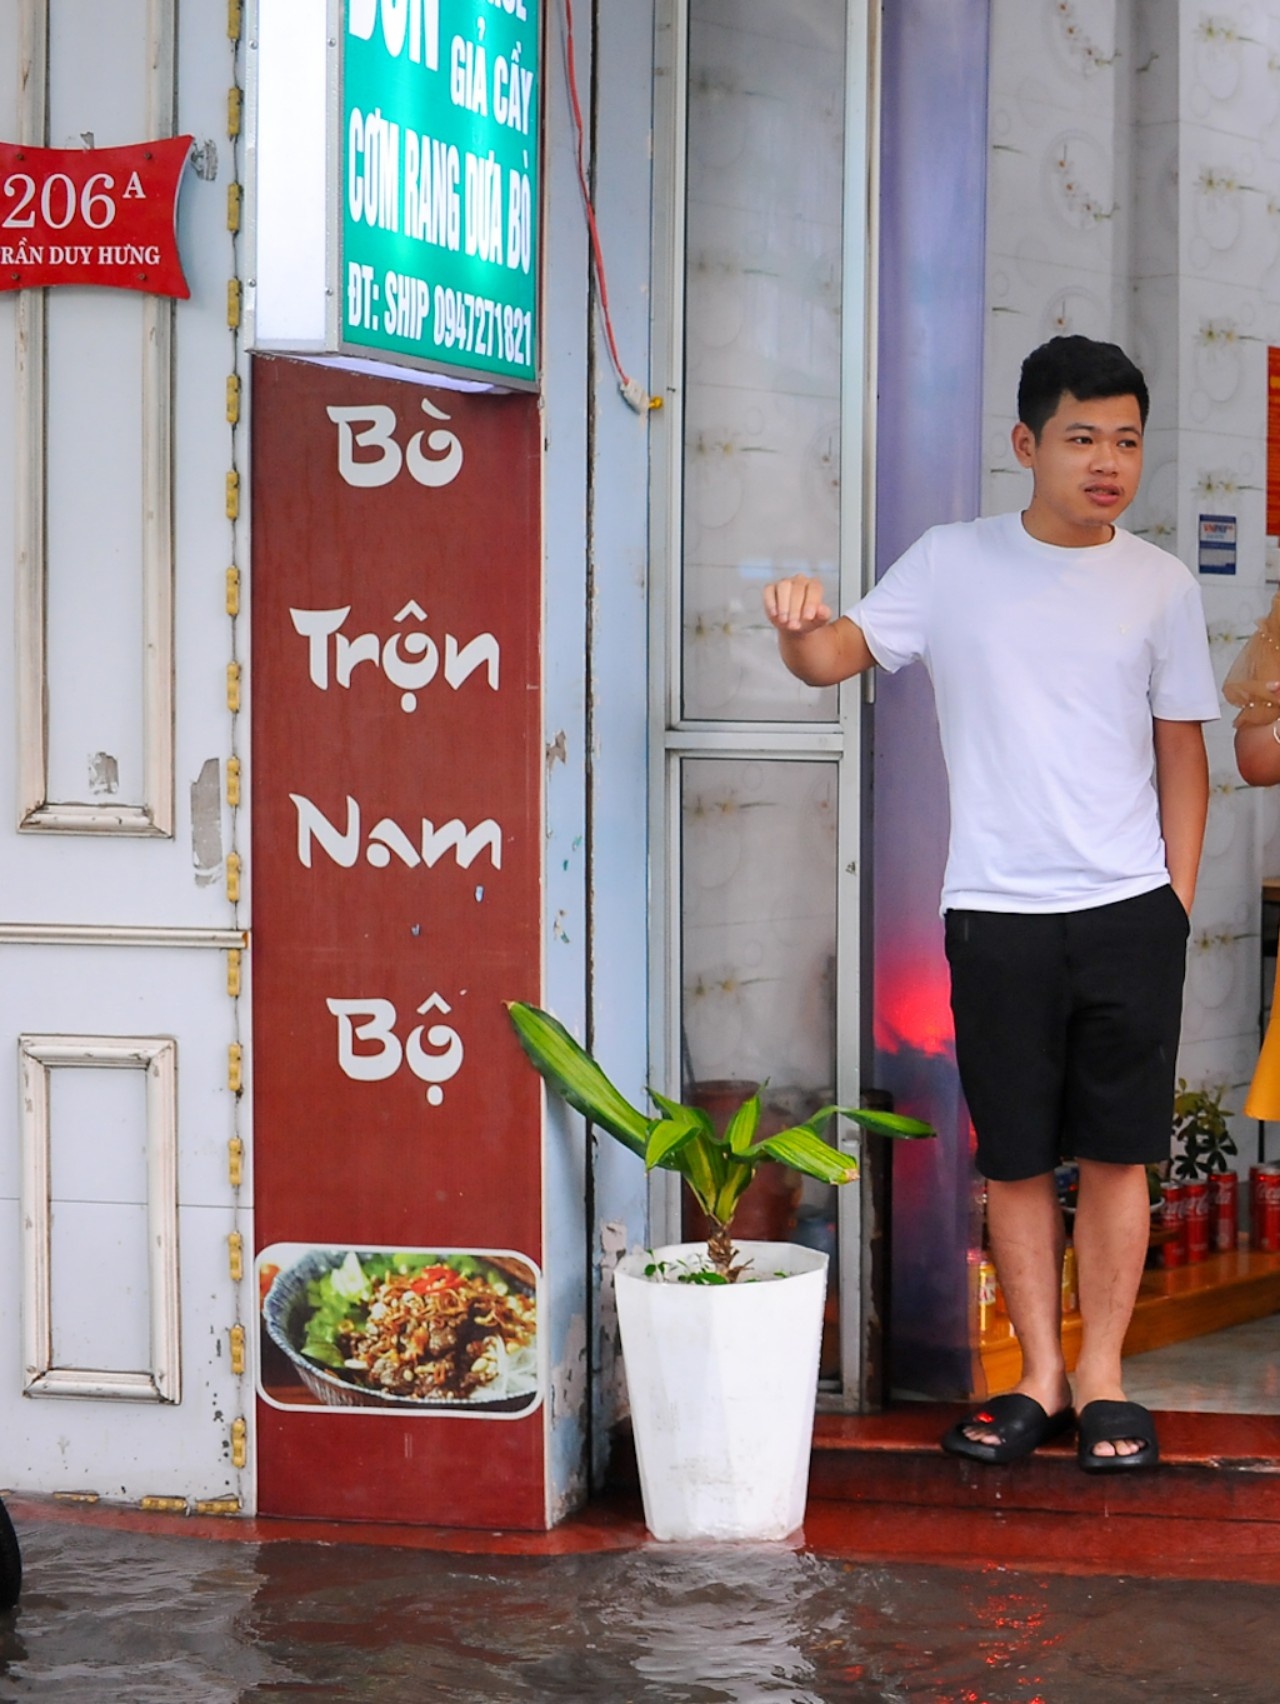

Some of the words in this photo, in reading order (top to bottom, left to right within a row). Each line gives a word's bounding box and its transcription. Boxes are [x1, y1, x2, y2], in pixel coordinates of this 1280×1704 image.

[451, 16, 488, 117] GIẢ
[494, 41, 533, 135] CẦY
[349, 107, 399, 233] CƠM
[404, 128, 460, 251] RANG
[465, 150, 503, 265] DƯA
[507, 150, 532, 275] BÒ
[0, 236, 43, 265] RẦN
[49, 246, 93, 265] DUY
[98, 243, 161, 265] HƯNG
[348, 261, 379, 331] ĐT:
[384, 271, 429, 340] SHIP
[434, 285, 532, 366] 0947271821
[327, 398, 463, 487] Bò
[290, 600, 500, 713] Trộn
[289, 793, 501, 869] Nam
[327, 992, 463, 1106] Bộ
